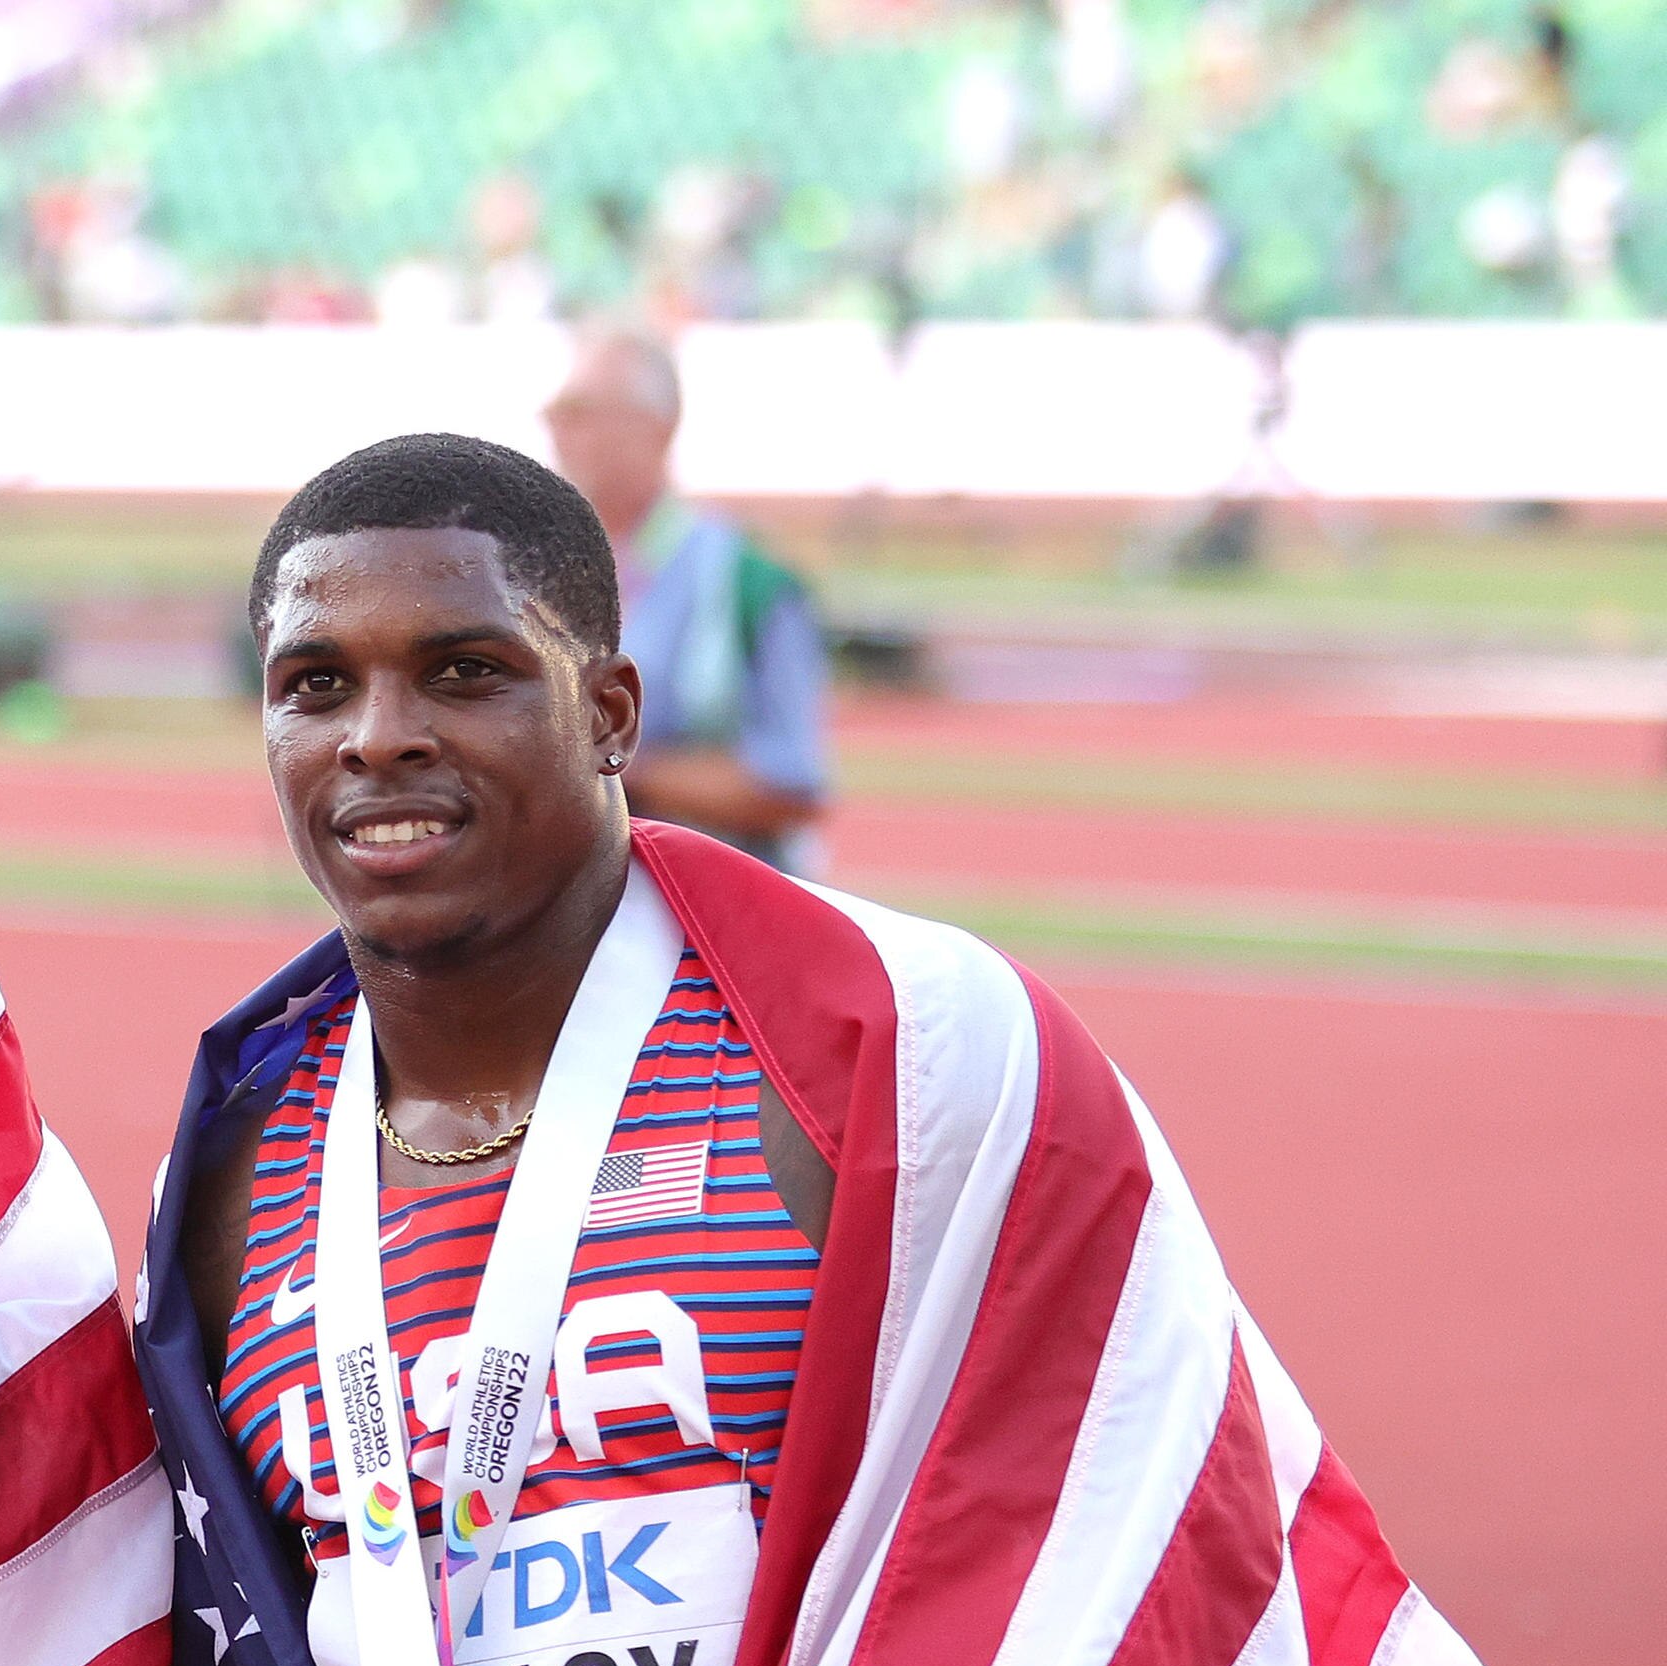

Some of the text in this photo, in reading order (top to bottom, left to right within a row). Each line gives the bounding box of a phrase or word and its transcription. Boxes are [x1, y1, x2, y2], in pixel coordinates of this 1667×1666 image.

[278, 1290, 715, 1522] USA
[337, 1354, 365, 1477] WORLD ATHLETICS
[347, 1350, 376, 1472] CHAMPIONSHIPS
[463, 1347, 495, 1473] WORLD ATHLETICS
[475, 1349, 509, 1478] CHAMPIONSHIPS
